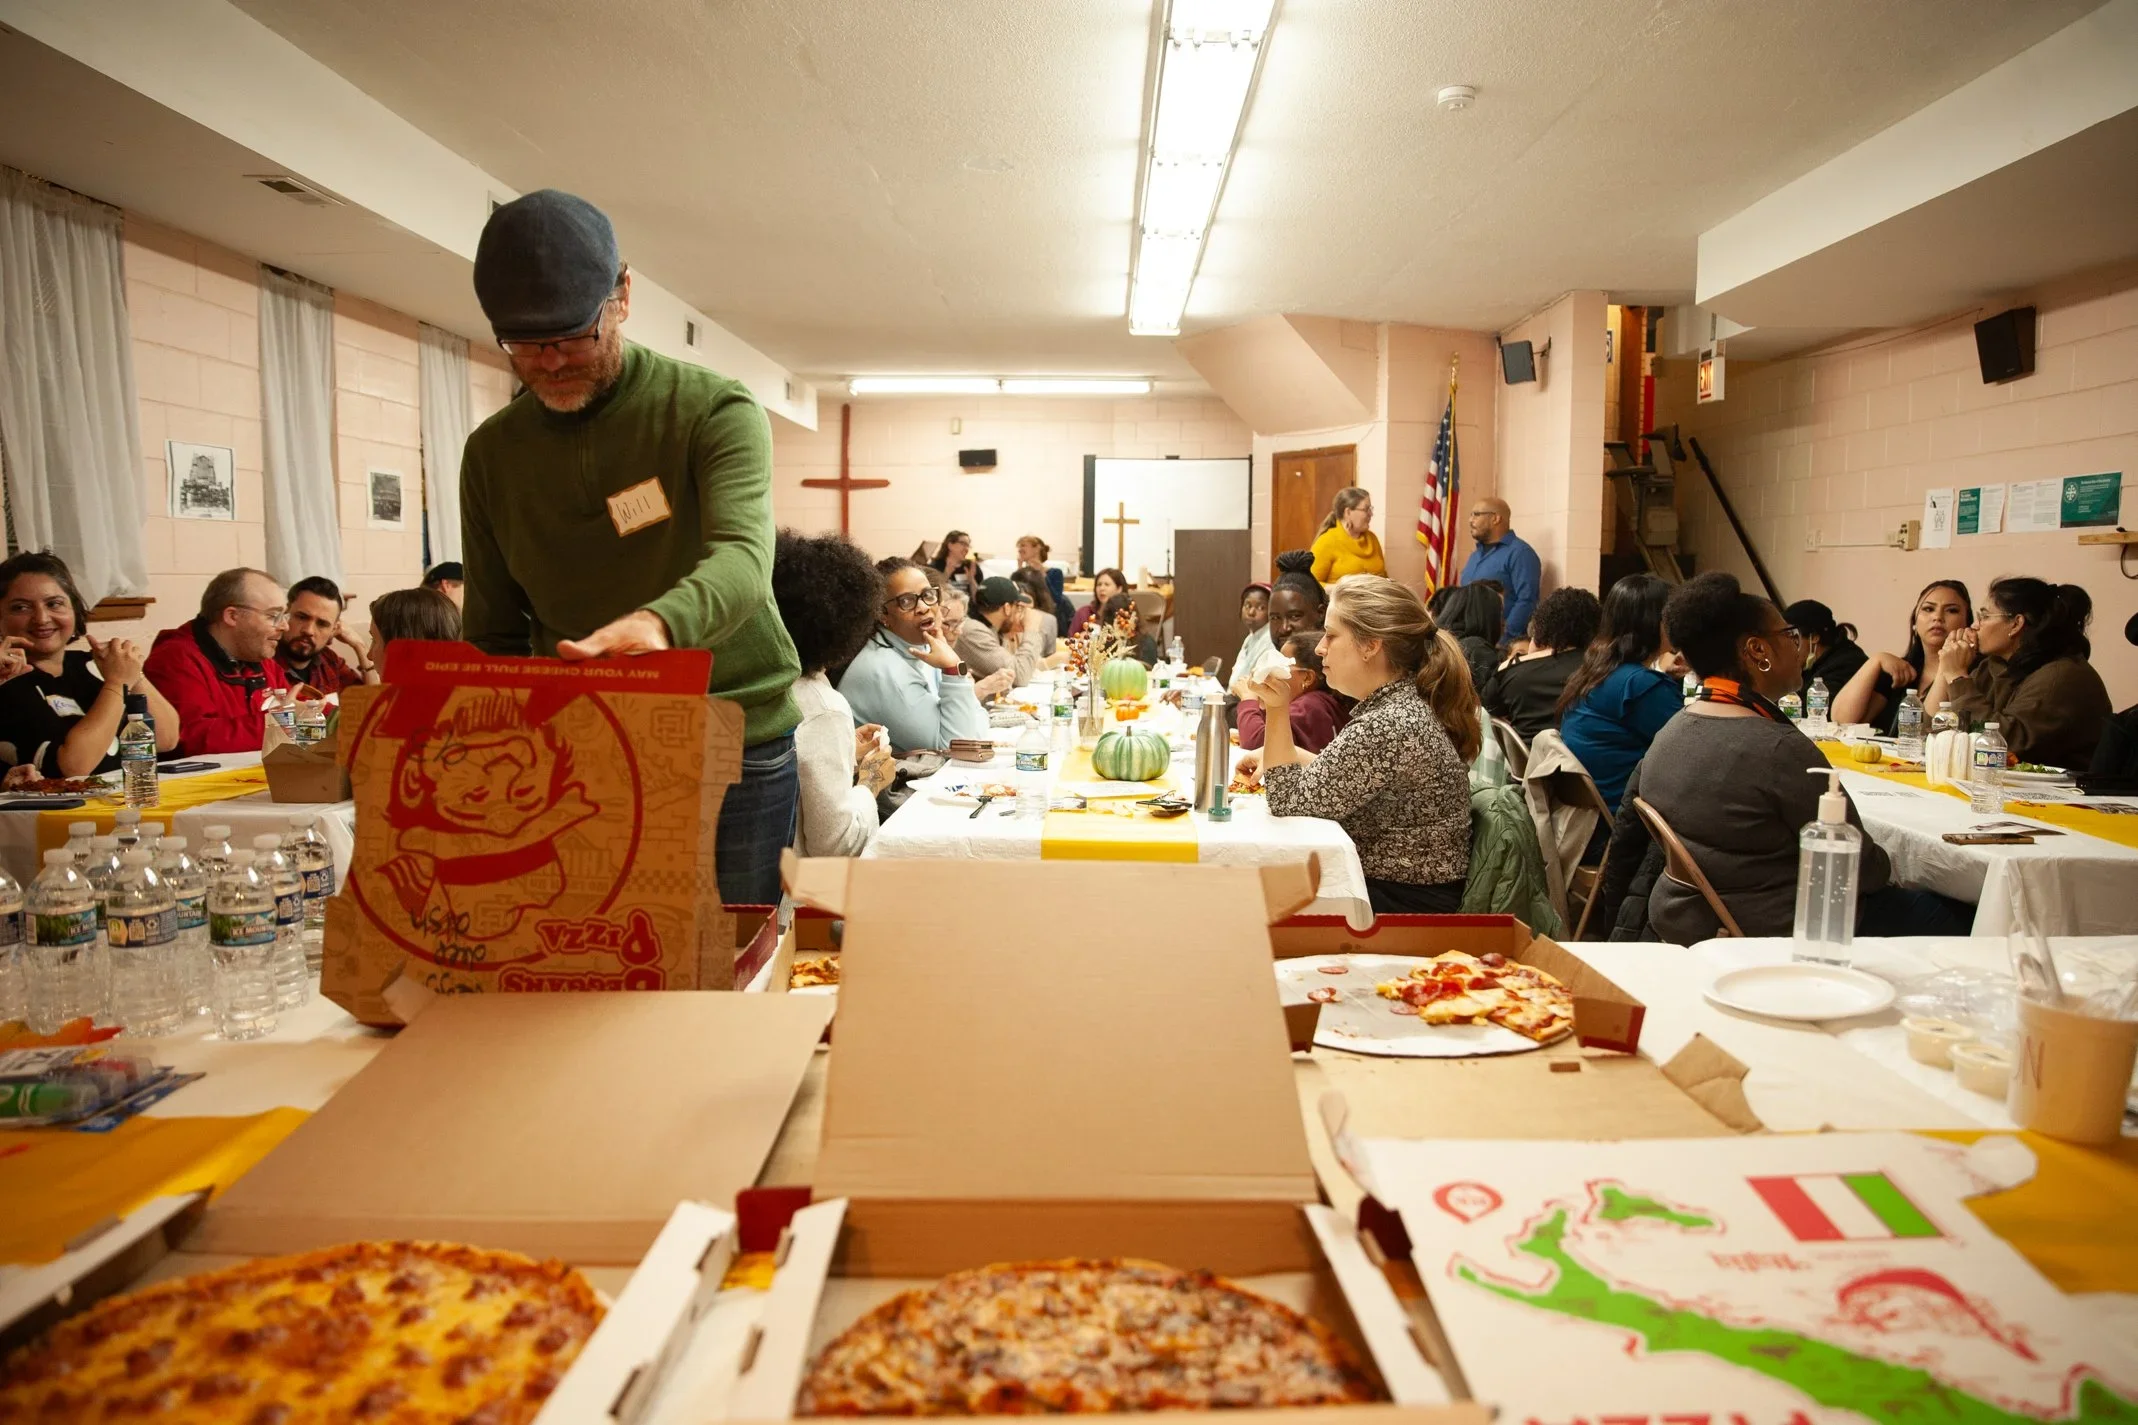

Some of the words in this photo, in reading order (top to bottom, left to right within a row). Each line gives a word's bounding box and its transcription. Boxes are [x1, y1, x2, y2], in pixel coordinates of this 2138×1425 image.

[1700, 361, 1713, 393] EXIT
[615, 495, 651, 524] Will
[425, 661, 459, 672] EPIC
[462, 662, 481, 672] BE
[485, 663, 519, 674] PULL
[522, 665, 580, 676] CHEESE
[583, 668, 624, 678] YOUR
[627, 669, 660, 679] MAY
[245, 923, 275, 935] MOUNT
[540, 914, 659, 965] PIZZA
